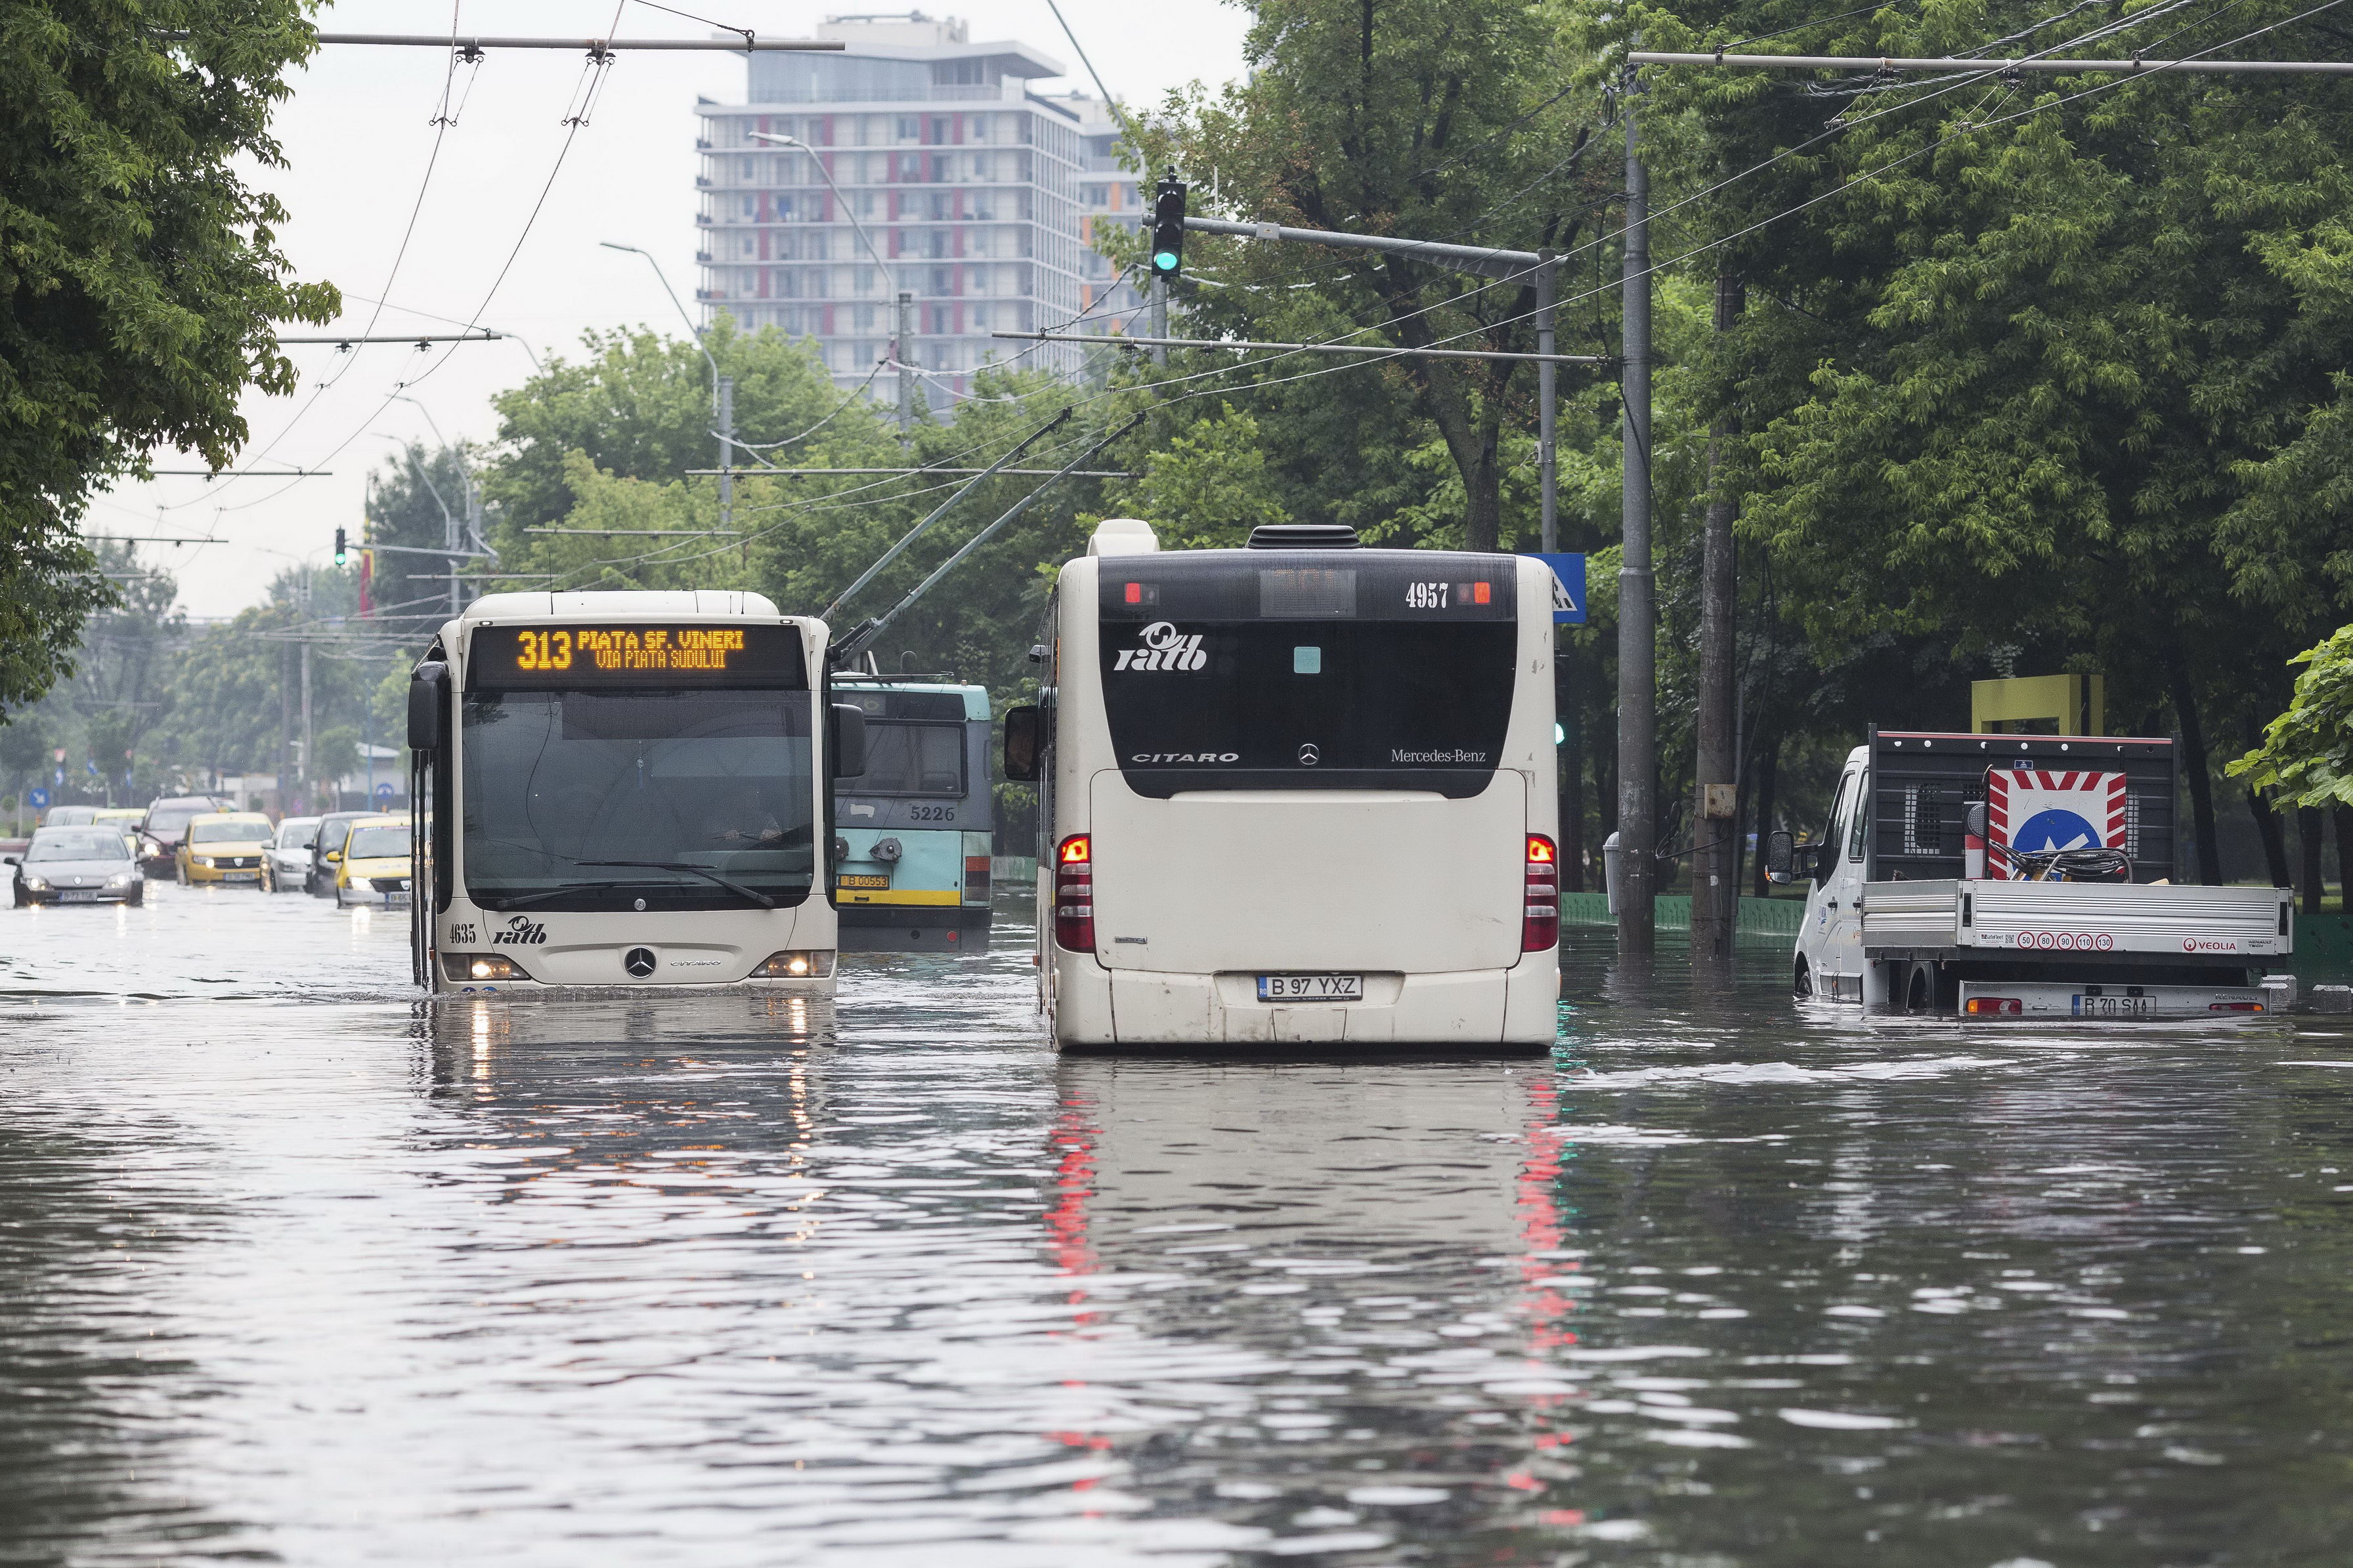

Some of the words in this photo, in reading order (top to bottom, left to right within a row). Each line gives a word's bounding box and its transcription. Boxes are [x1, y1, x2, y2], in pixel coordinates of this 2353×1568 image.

[1406, 582, 1448, 608] 4957
[578, 631, 639, 649] PIATA
[645, 631, 673, 649] SF.
[678, 631, 743, 649] VINERI
[519, 631, 571, 668] 313
[1113, 631, 1207, 670] ratb
[596, 650, 620, 667] VIA
[625, 650, 666, 667] PIATA
[671, 650, 725, 667] SUDULUI
[1131, 753, 1239, 762] CITARO
[1391, 749, 1486, 762] Mercedes-Benz
[911, 807, 955, 821] 5226
[849, 877, 855, 885] B
[859, 876, 886, 885] 00553
[450, 923, 476, 944] 4635
[492, 922, 547, 944] ratb
[1272, 979, 1284, 994] B
[1291, 978, 1311, 994] 97
[1318, 978, 1355, 994] YXZ
